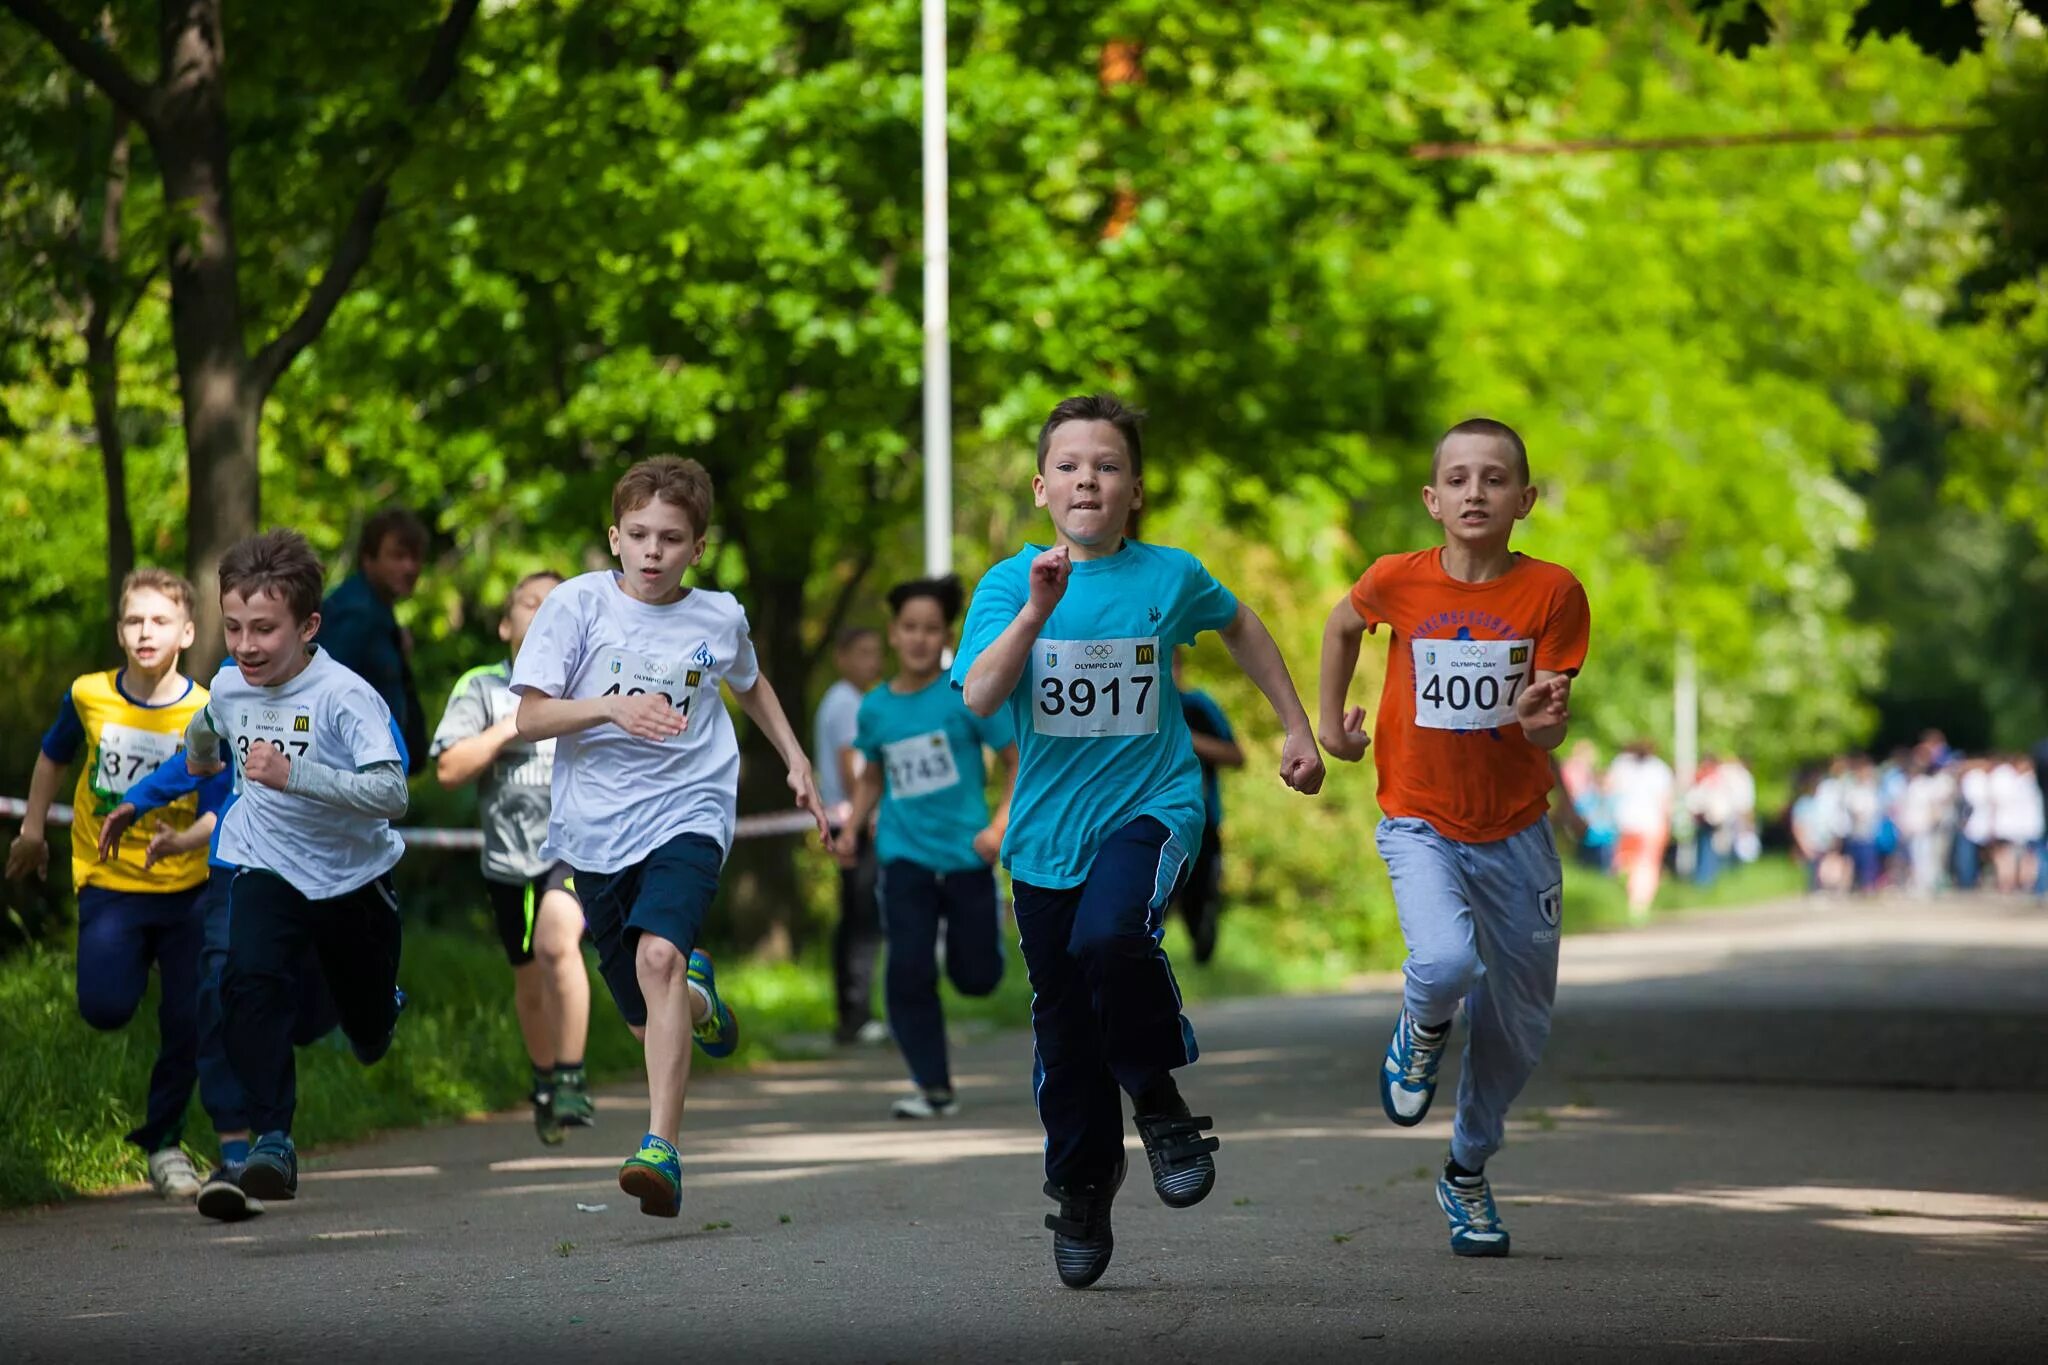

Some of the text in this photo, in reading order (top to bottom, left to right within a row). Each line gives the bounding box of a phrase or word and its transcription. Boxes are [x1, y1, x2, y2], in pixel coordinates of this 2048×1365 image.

[1074, 662, 1108, 670] OLYMPIC
[1040, 675, 1154, 717] 3917
[1422, 672, 1524, 711] 4007
